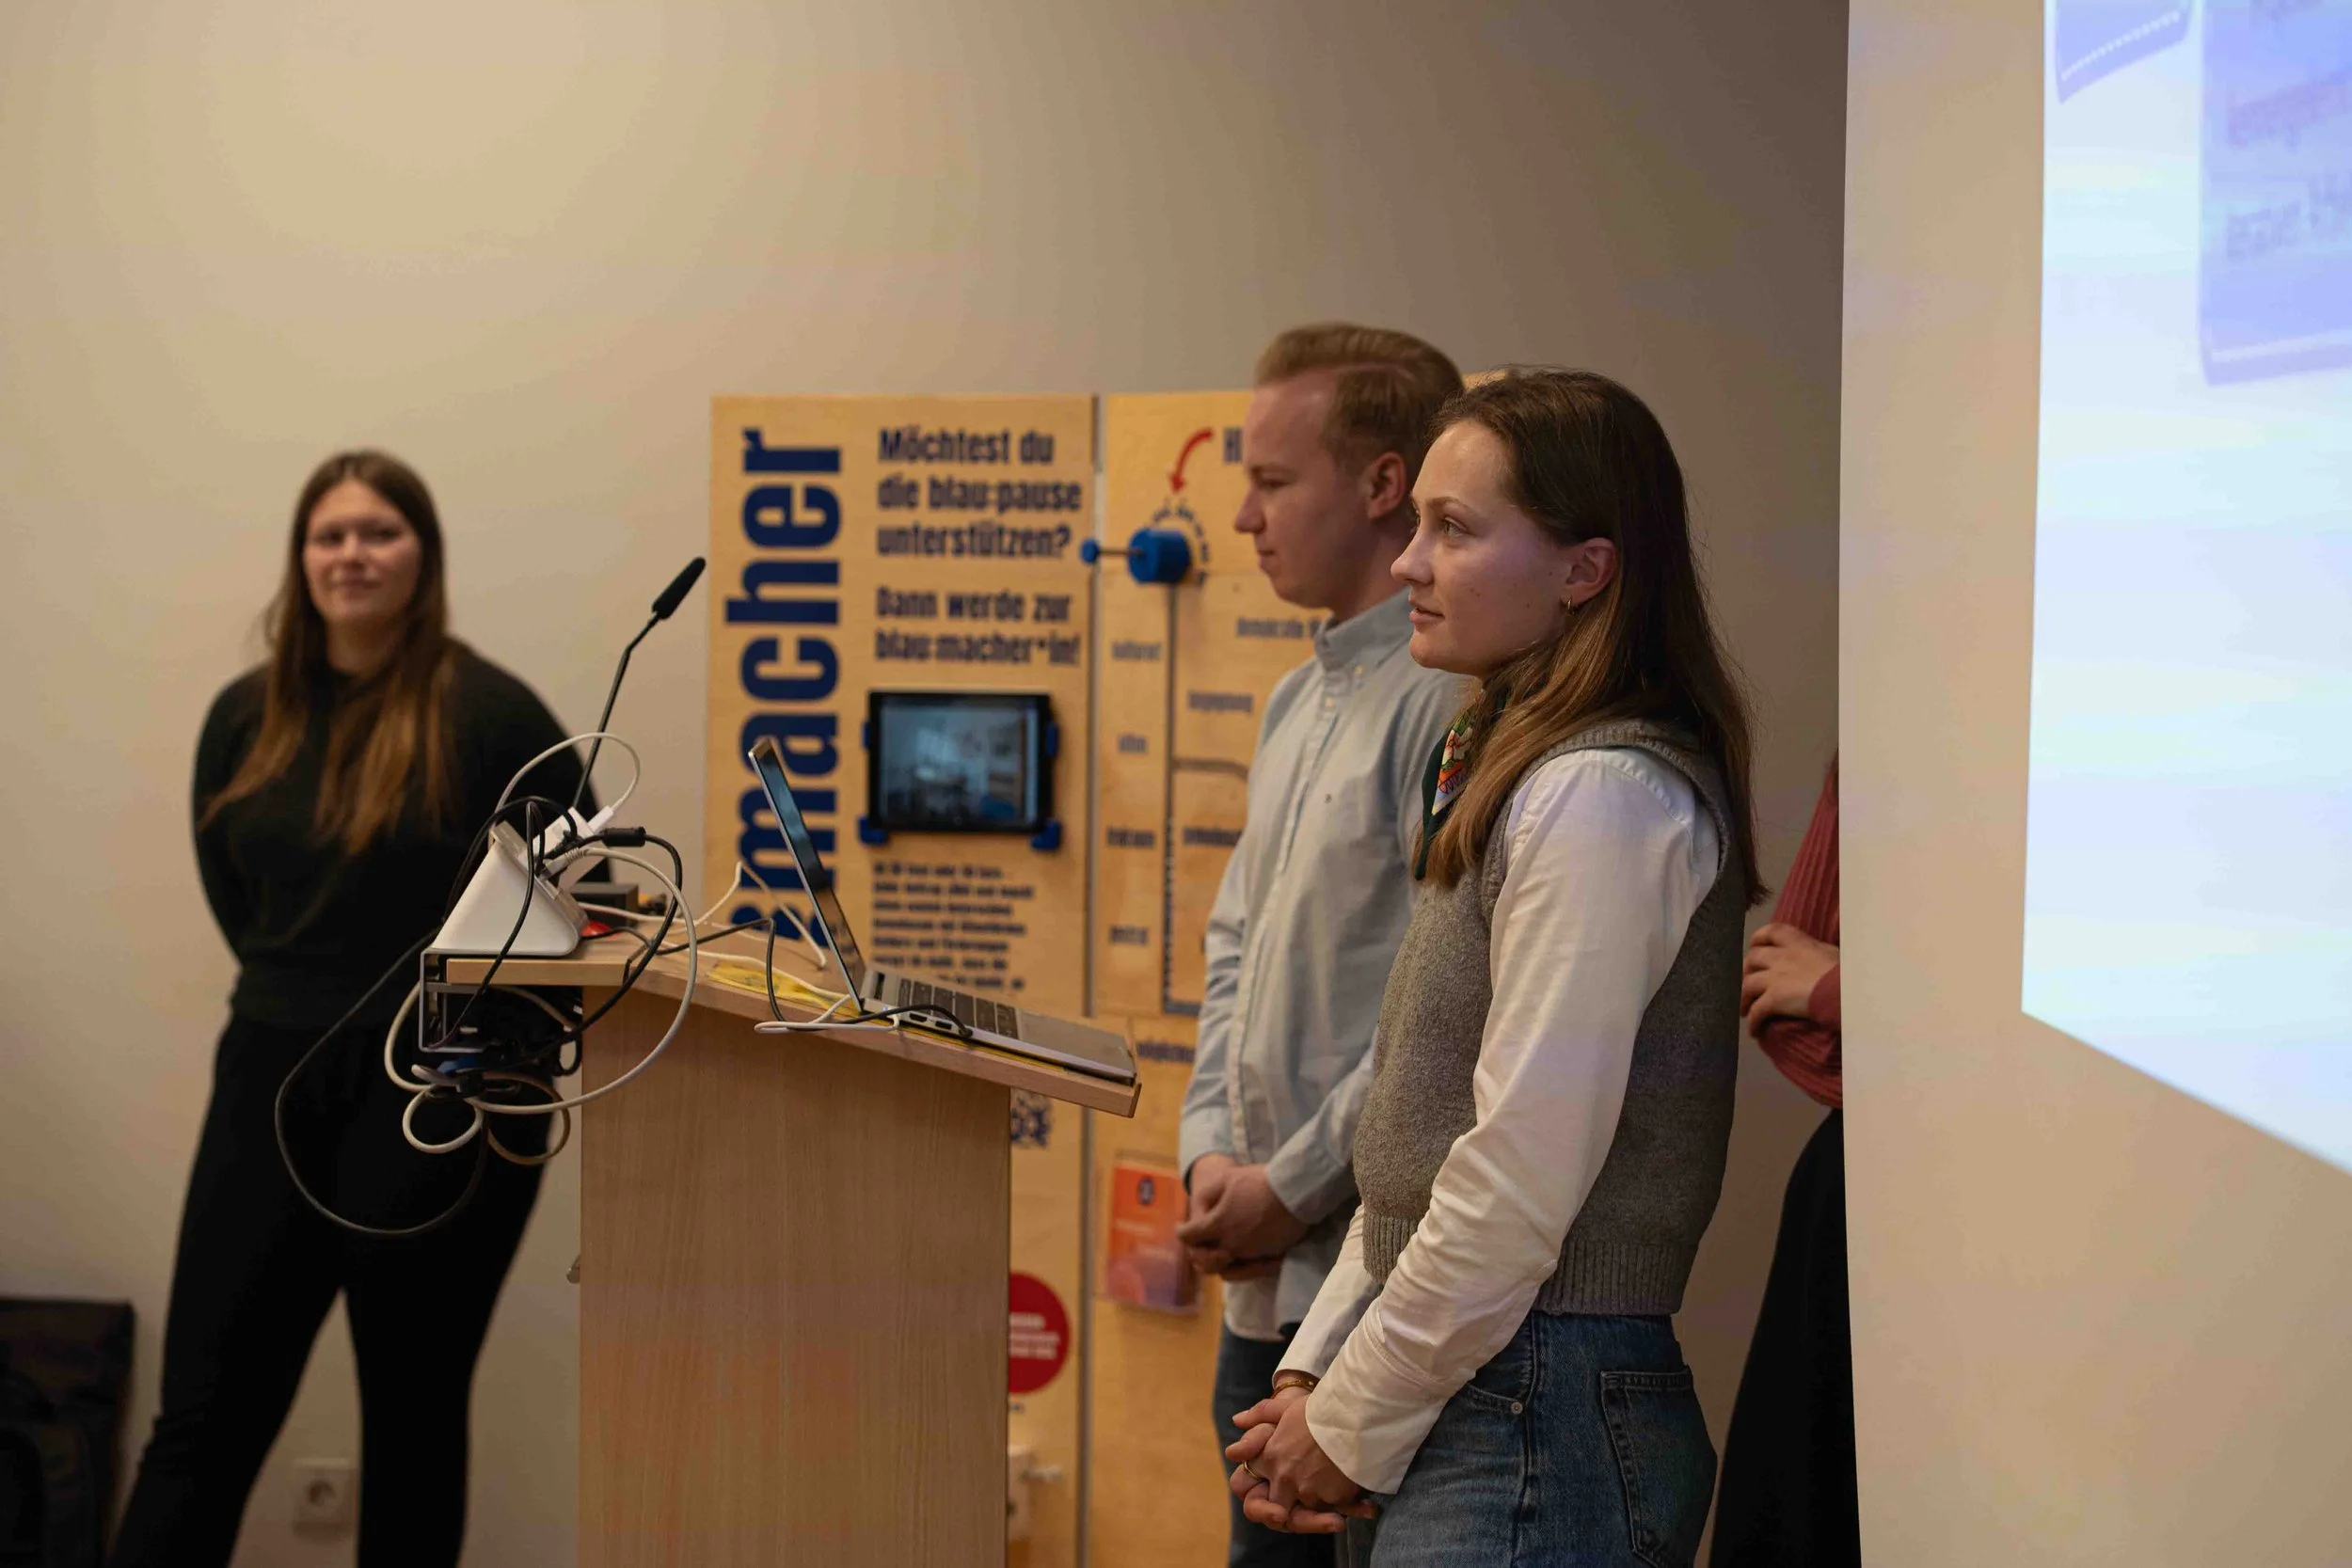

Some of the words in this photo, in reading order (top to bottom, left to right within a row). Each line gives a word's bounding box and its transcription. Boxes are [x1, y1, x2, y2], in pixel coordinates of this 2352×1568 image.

[877, 425, 1013, 466] Möchtest
[1019, 429, 1056, 466] du
[876, 473, 921, 511] die
[876, 520, 1073, 561] unterstützen?
[876, 585, 938, 621] Dann
[945, 588, 1025, 623] werde
[1032, 592, 1073, 625] zur
